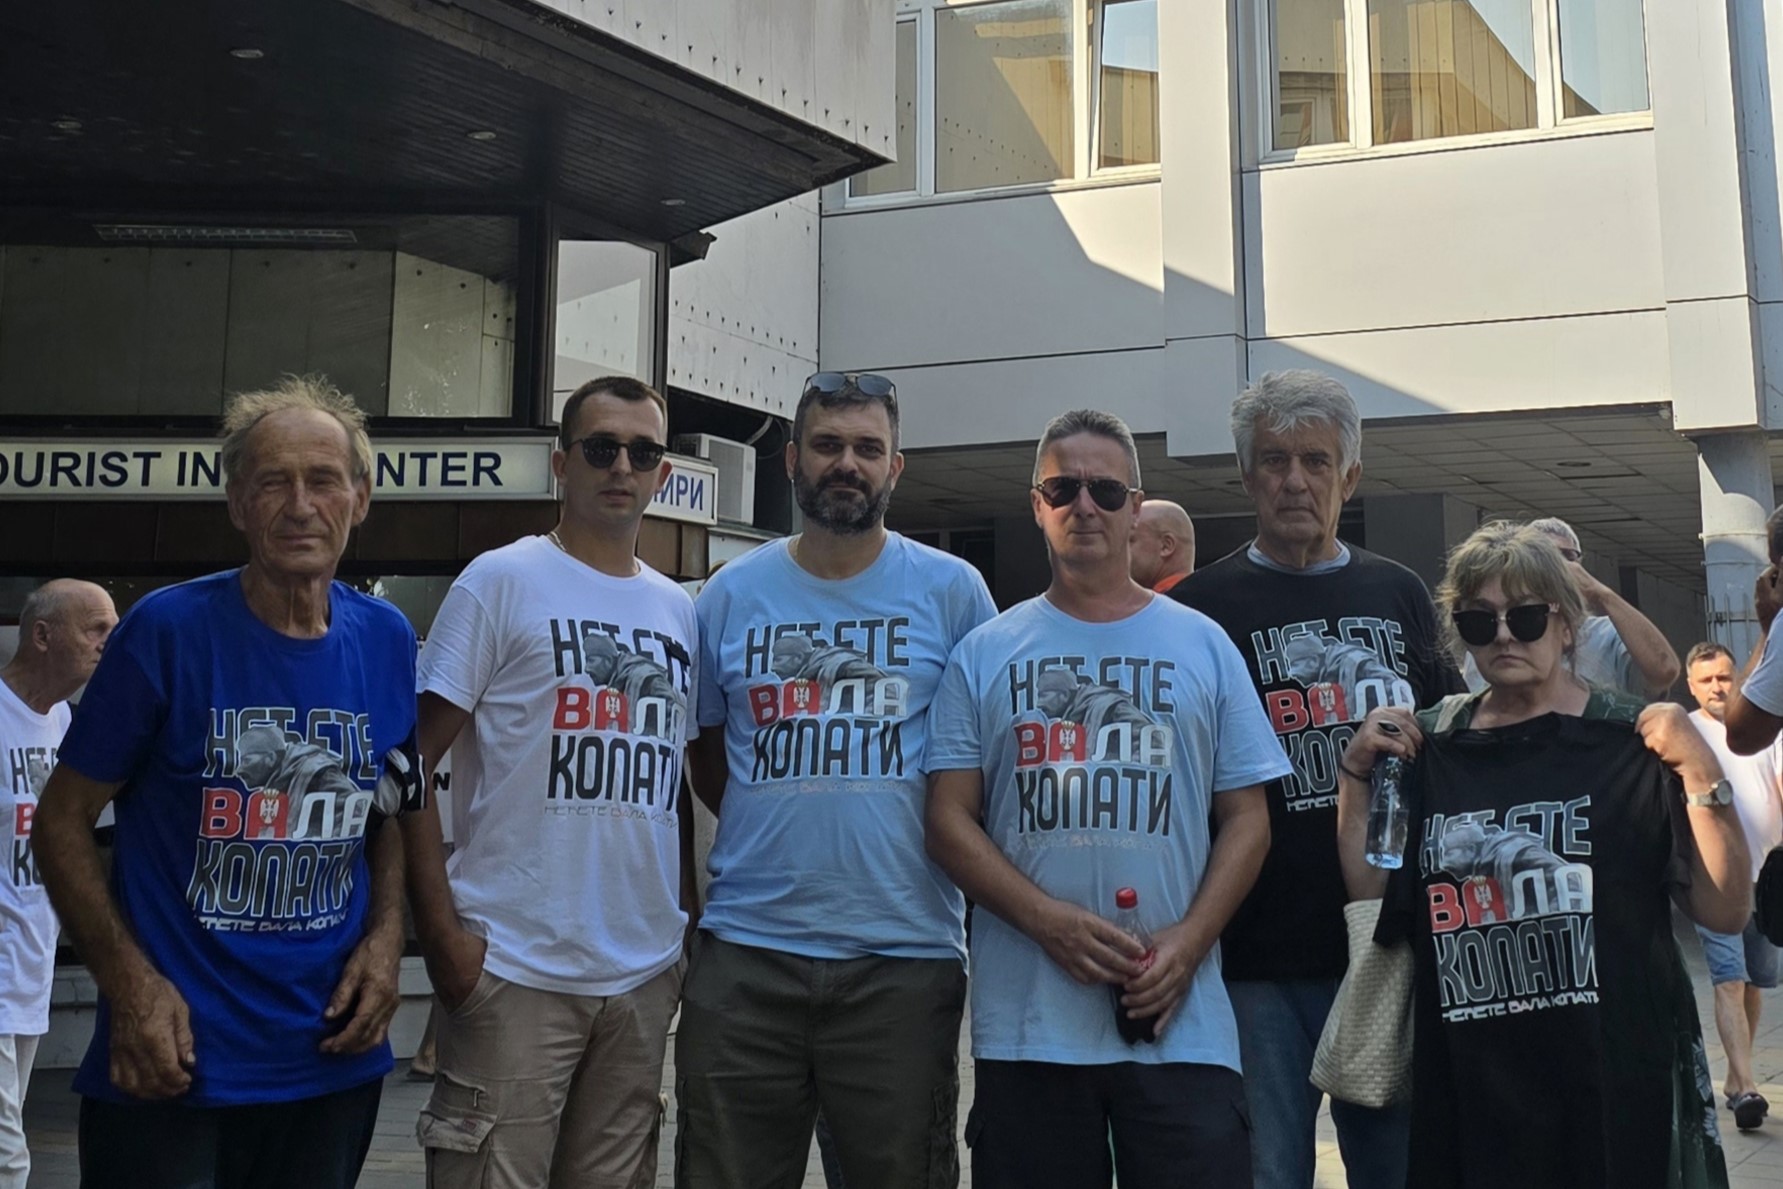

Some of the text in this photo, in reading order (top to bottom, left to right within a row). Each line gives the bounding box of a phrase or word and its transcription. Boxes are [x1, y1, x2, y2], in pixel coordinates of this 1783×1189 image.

[0, 451, 162, 488] URIST
[749, 677, 909, 728] ВАЛА
[750, 716, 904, 783] КОПАТИ
[1013, 720, 1175, 768] ВАЛА
[199, 786, 376, 842] ВАЛА
[1014, 766, 1173, 837] КОПАТИ
[1426, 863, 1594, 933] ВАЛА
[1433, 914, 1599, 1007] КОПАТИ
